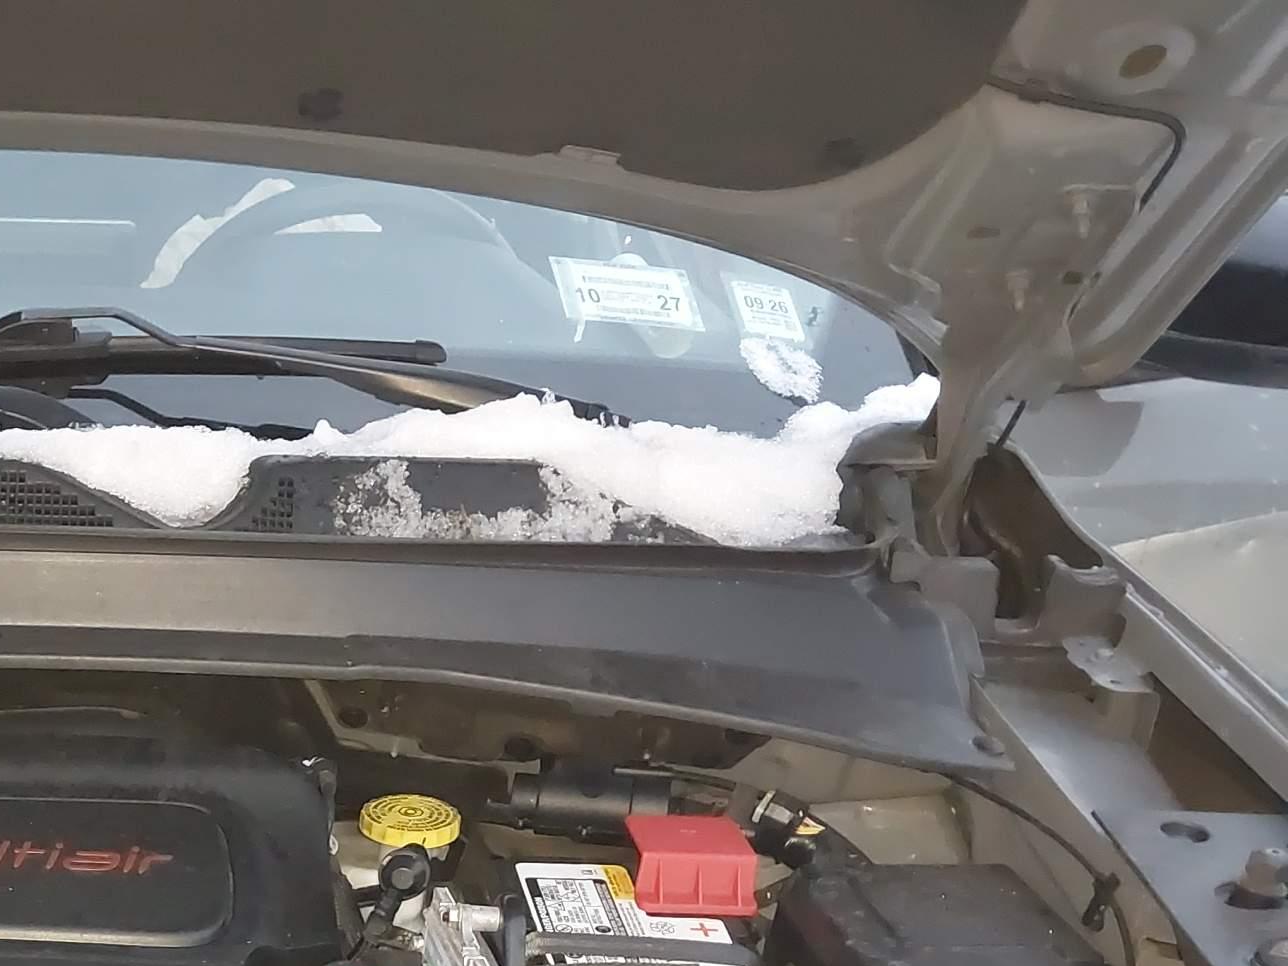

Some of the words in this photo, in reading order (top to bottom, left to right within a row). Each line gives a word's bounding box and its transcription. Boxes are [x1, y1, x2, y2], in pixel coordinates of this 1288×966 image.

[575, 287, 601, 304] 10
[657, 294, 681, 312] 27
[744, 295, 764, 310] 09
[769, 299, 789, 314] 26
